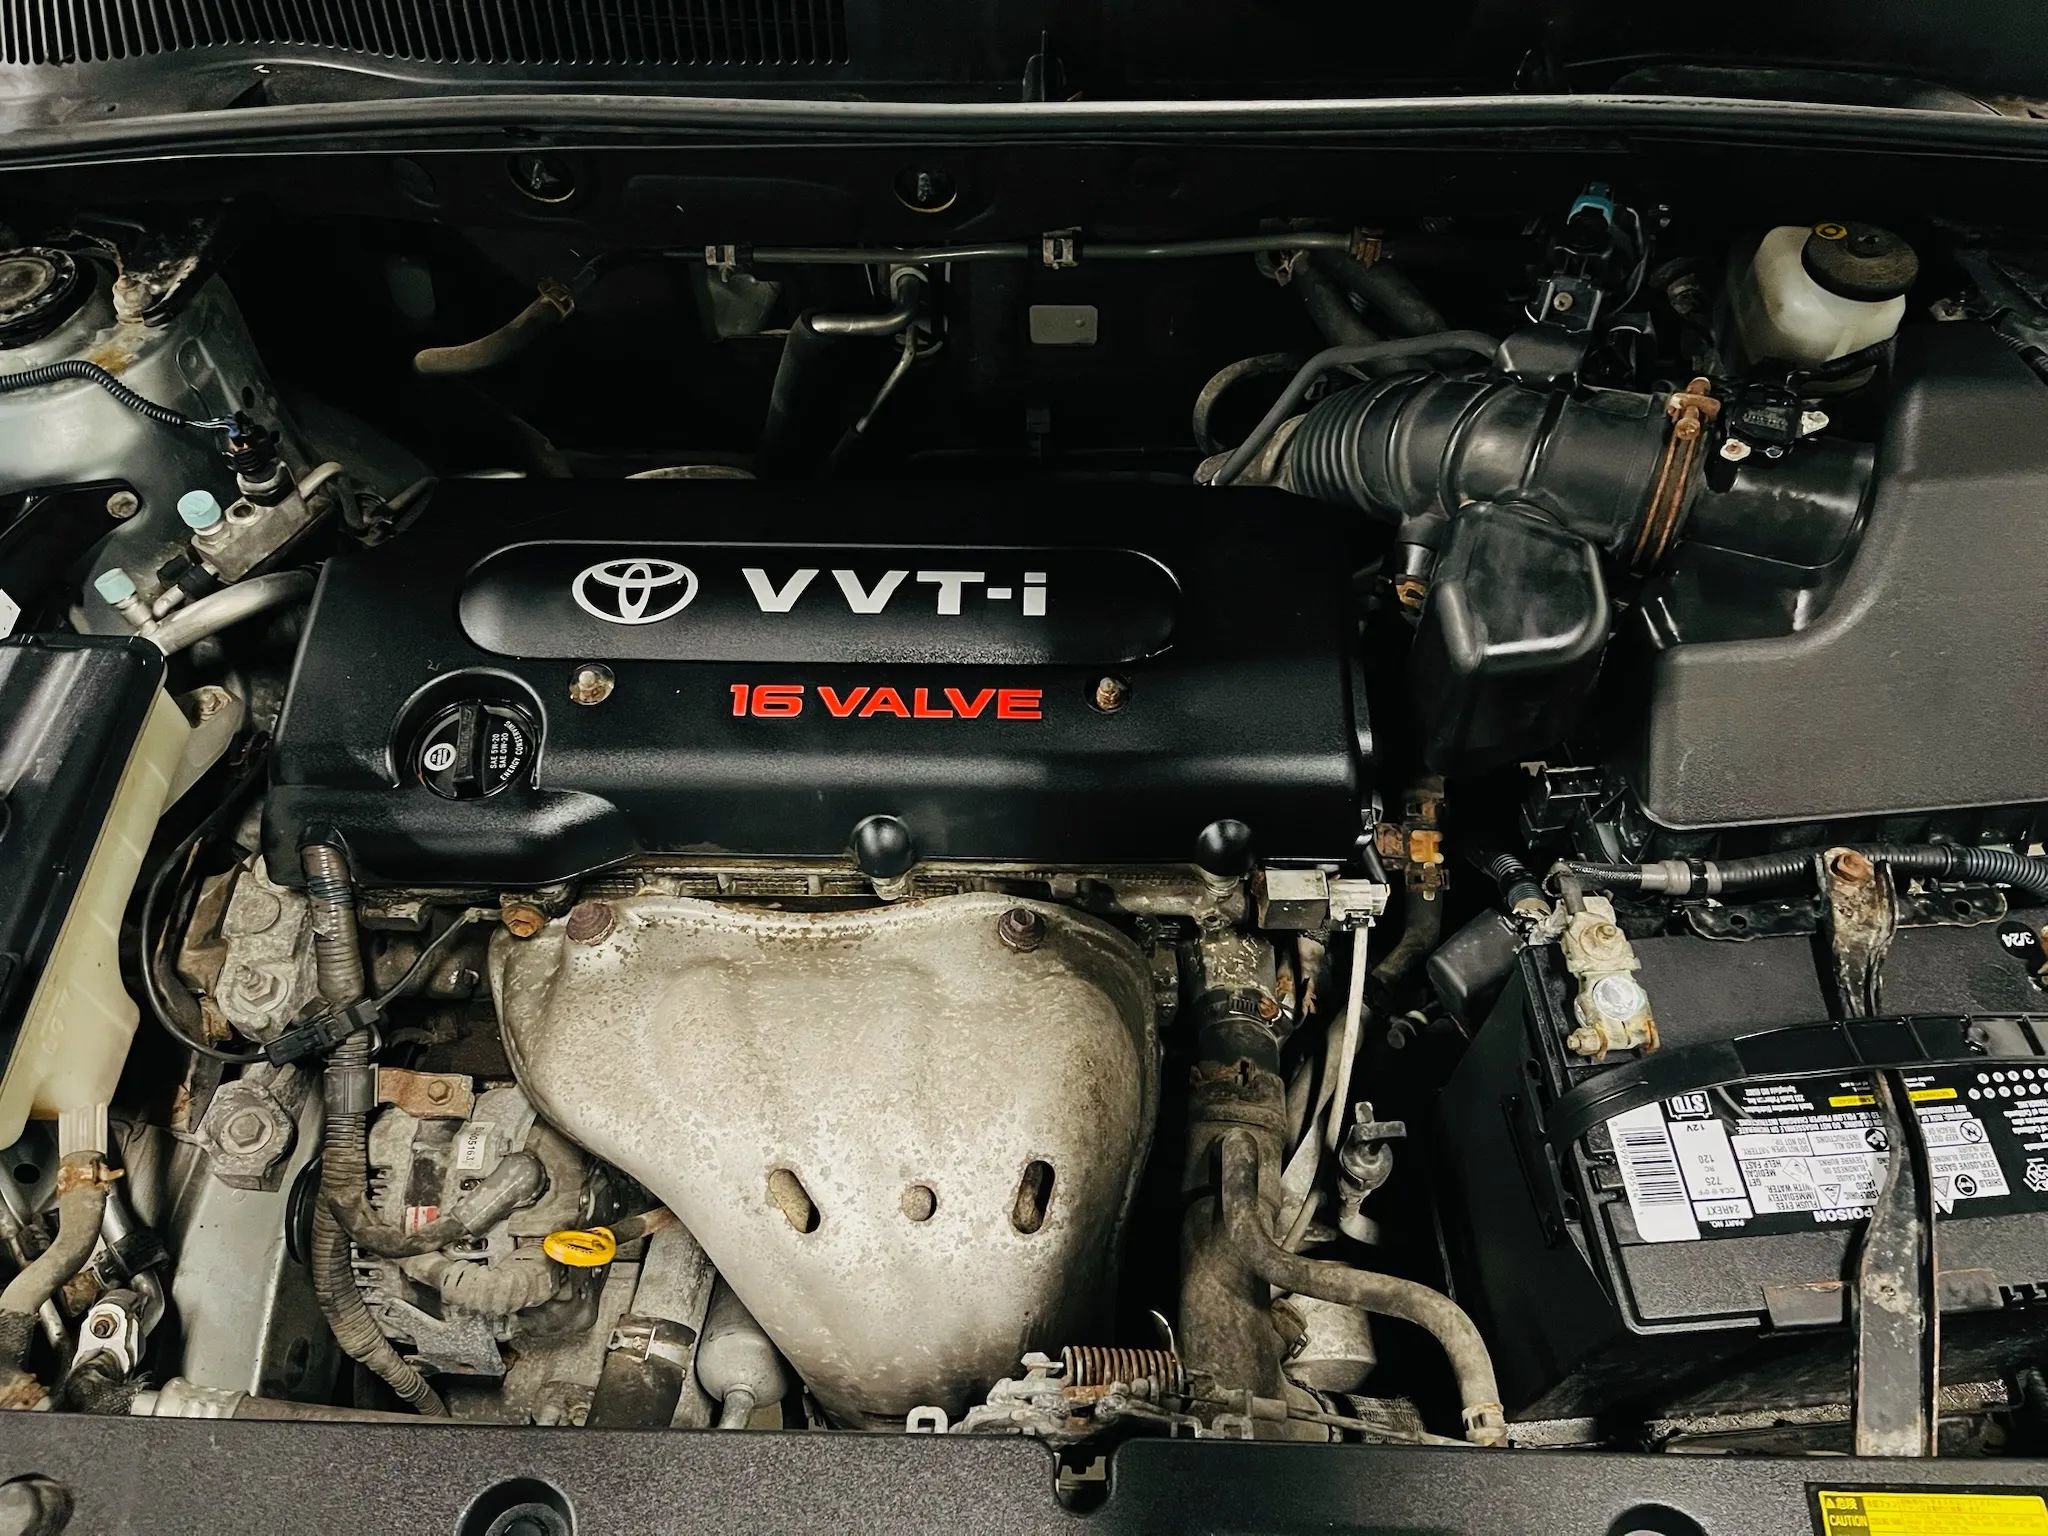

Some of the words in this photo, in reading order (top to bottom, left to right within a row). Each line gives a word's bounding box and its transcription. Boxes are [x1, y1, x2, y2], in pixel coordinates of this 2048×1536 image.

[742, 568, 1046, 616] VVT-i
[730, 684, 805, 717] 16
[817, 686, 1042, 719] VALVE
[504, 721, 523, 755] CONSERVING
[490, 756, 498, 769] SAE
[499, 755, 507, 769] SAE
[500, 757, 520, 780] ENERGY
[1672, 1095, 1705, 1113] STD
[1687, 1124, 1705, 1132] 12V
[1698, 1154, 1714, 1164] 120
[1764, 1159, 1782, 1169] HELP
[1960, 1160, 1996, 1170] EXPLOSIVE
[1746, 1169, 1777, 1178] MEDICAL
[1705, 1176, 1721, 1186] 725
[1749, 1179, 1762, 1187] GET
[1768, 1192, 1815, 1202] IMMEDIATELY
[1776, 1201, 1795, 1211] EYES
[1799, 1200, 1819, 1209] FLUSH
[1706, 1204, 1741, 1216] 24REXT
[1813, 1206, 1873, 1223] POISON
[1725, 1219, 1745, 1227] PART
[1830, 1514, 1868, 1527] CAUTION
